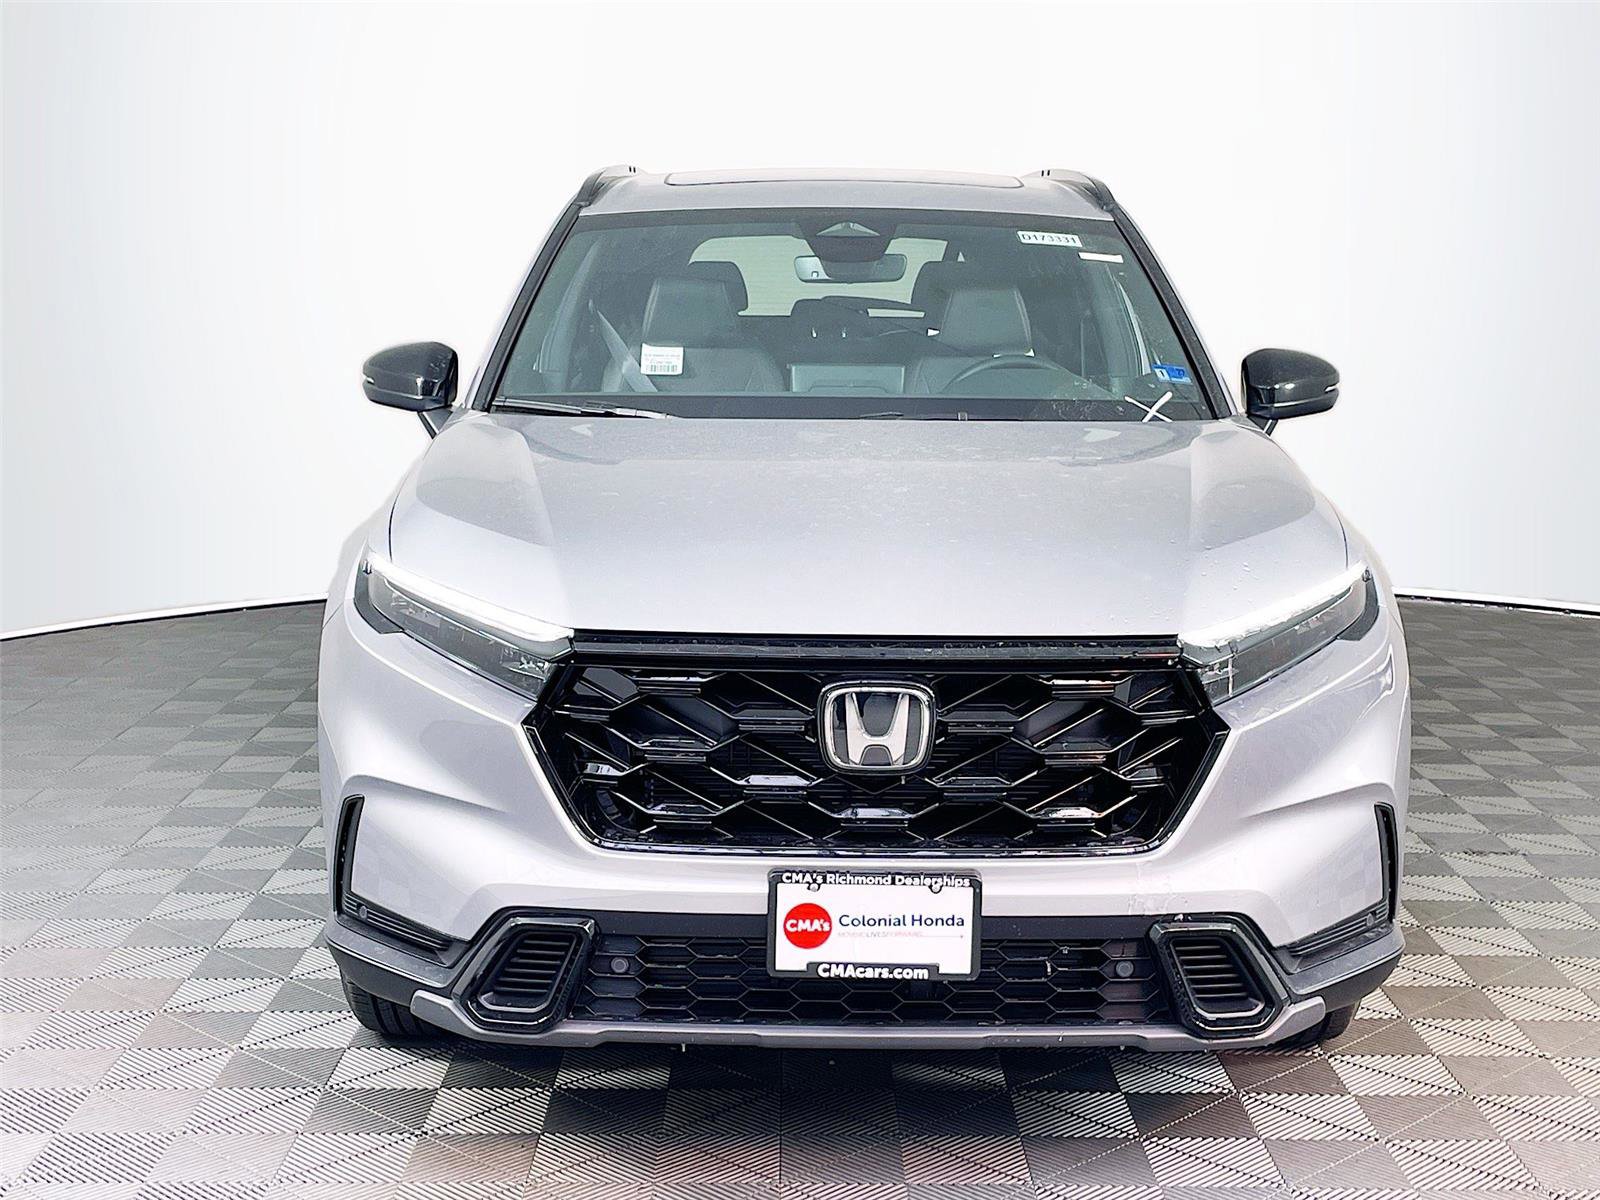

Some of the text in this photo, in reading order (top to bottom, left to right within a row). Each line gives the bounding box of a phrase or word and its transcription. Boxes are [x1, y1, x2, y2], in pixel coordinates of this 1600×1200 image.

[782, 872, 970, 887] CMA's Richmond Dealerships
[785, 918, 830, 932] CMA's
[839, 914, 964, 927] Colonial Honda
[817, 963, 929, 979] CMAcars.com
